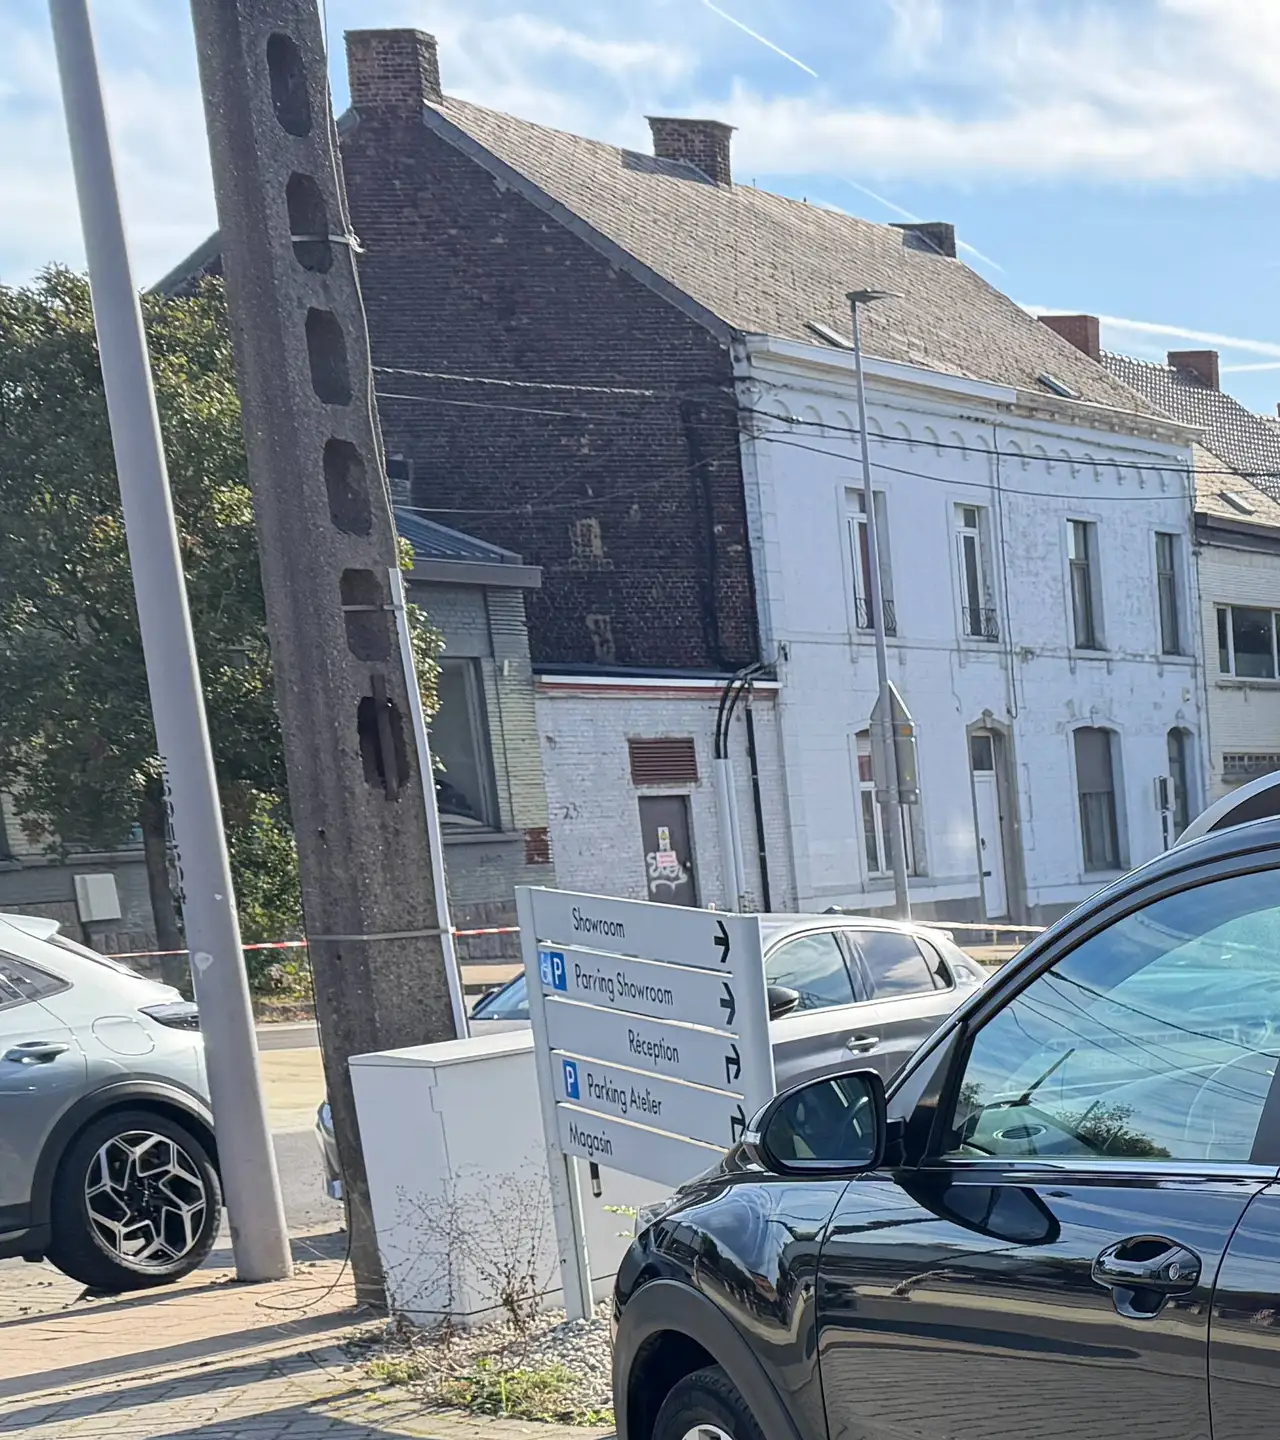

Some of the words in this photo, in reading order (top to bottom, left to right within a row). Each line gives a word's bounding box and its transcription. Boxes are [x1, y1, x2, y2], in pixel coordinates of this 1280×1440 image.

[572, 907, 625, 939] Showroom
[616, 971, 674, 1006] Showroom
[628, 1028, 680, 1066] Réception
[587, 1073, 627, 1114] Parking
[629, 1084, 662, 1116] Atelier
[569, 1122, 613, 1157] Magasin
